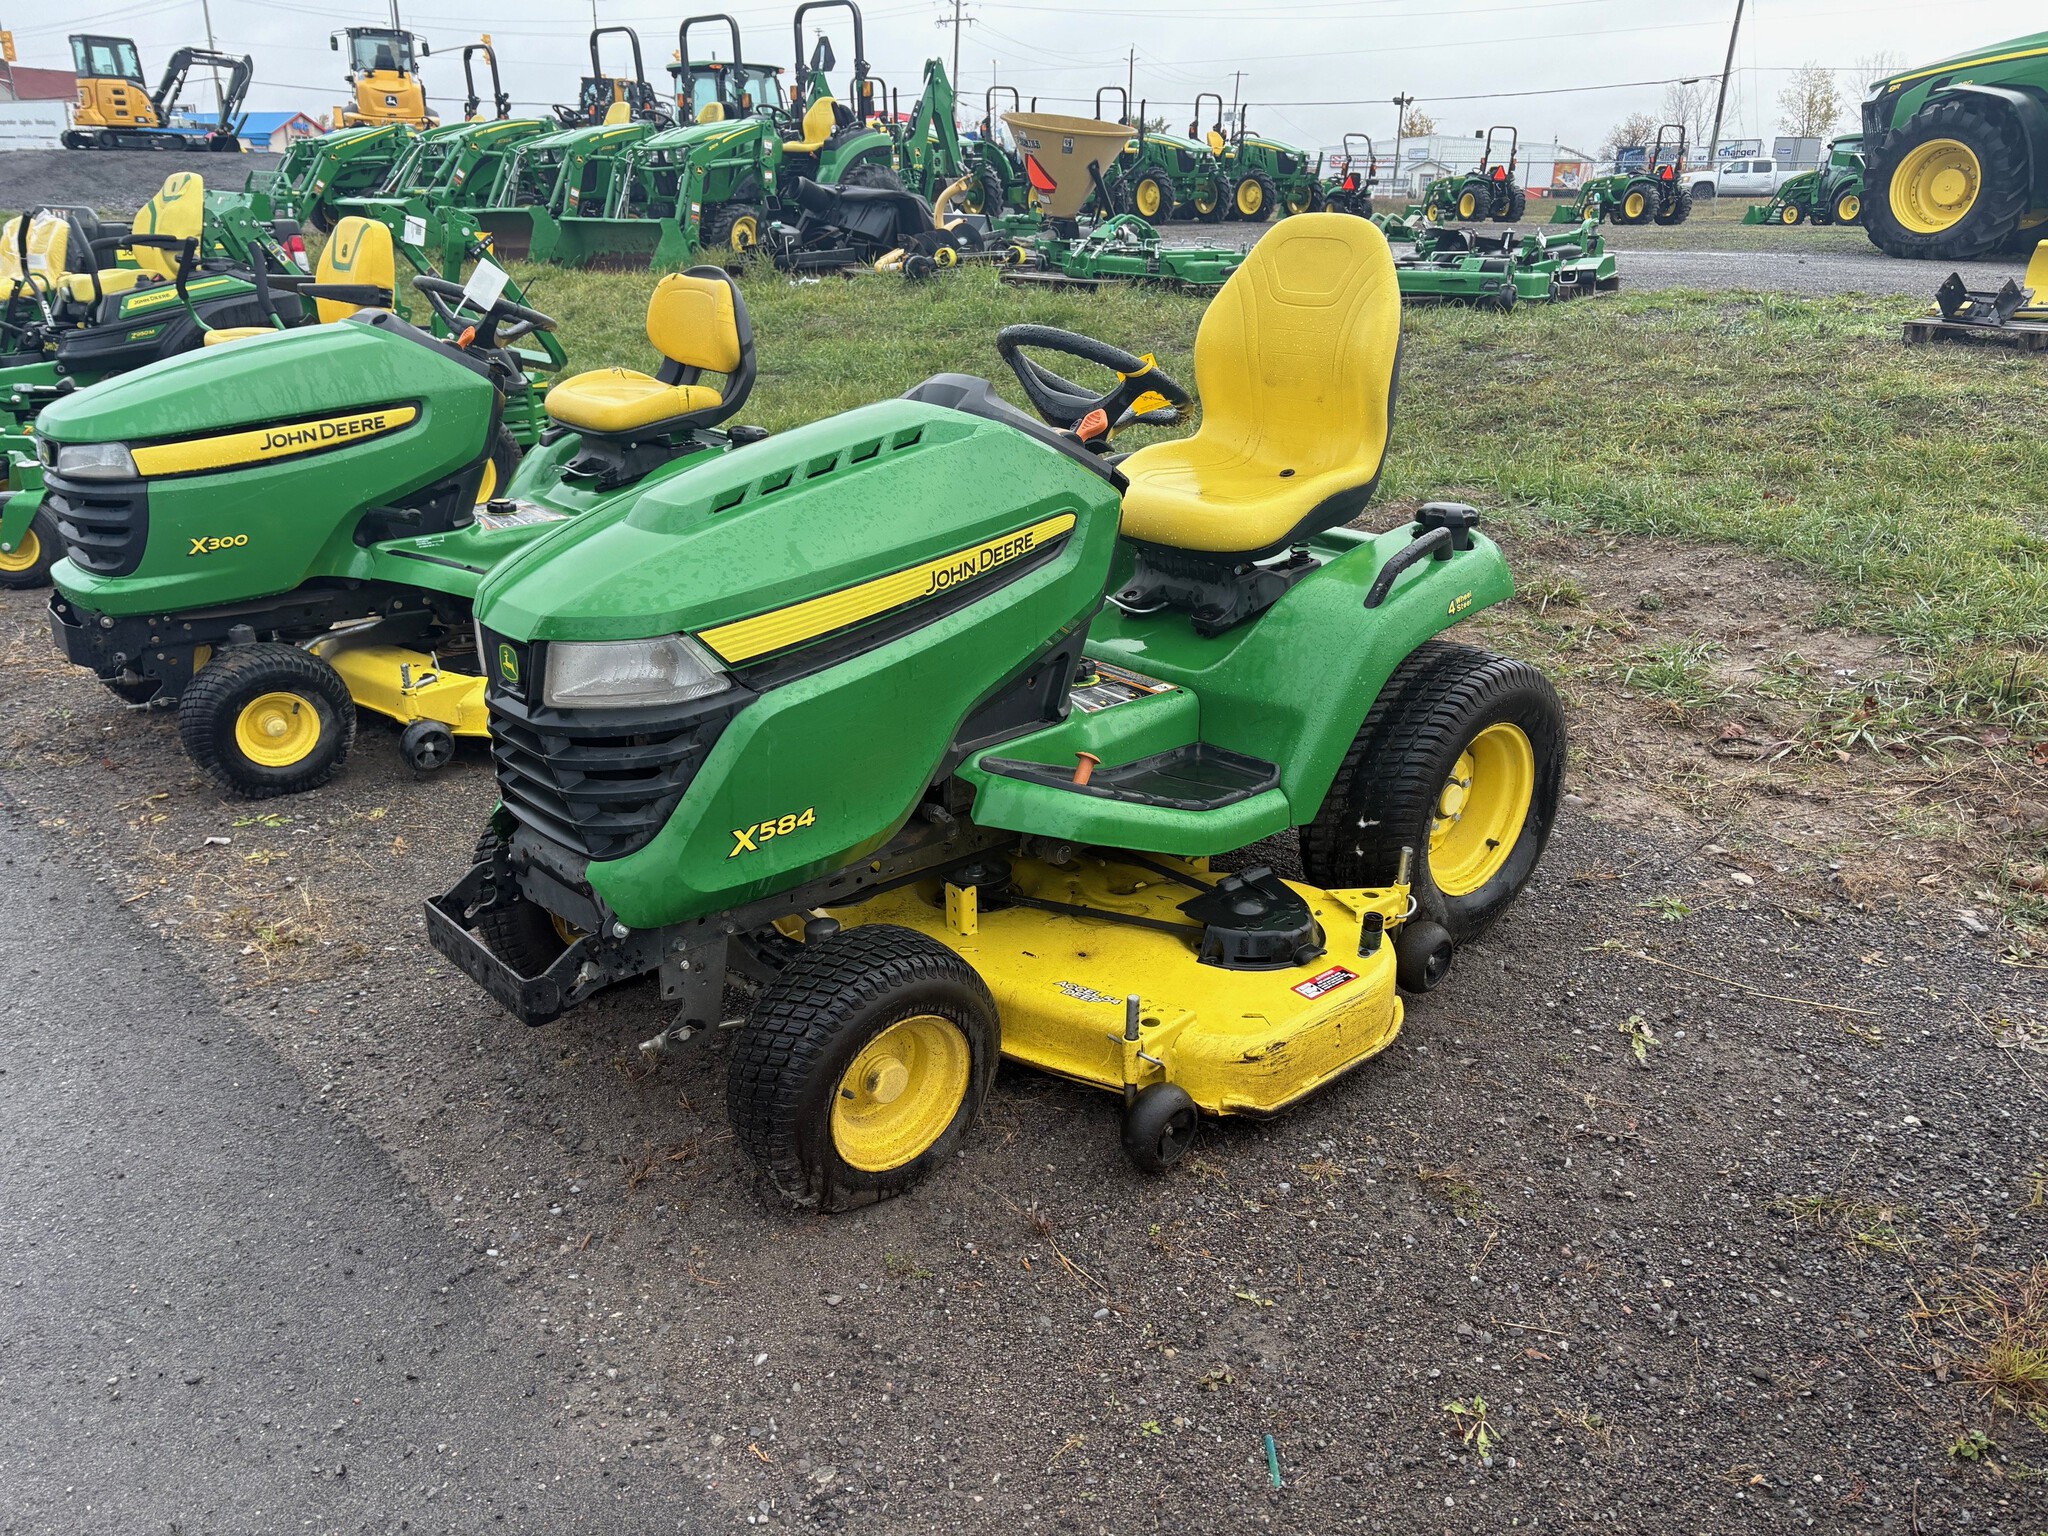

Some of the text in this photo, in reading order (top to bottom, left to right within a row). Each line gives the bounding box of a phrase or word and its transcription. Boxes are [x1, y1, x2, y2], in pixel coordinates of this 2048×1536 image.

[1718, 147, 1757, 159] Charger
[134, 293, 170, 305] JOHN DEERE
[260, 416, 386, 450] JOHN DEERE
[188, 533, 249, 555] X300
[925, 531, 1034, 594] JOHN DEERE
[1448, 590, 1472, 615] 4 Wheel
[1457, 599, 1472, 612] Steer
[726, 806, 816, 859] X584
[1053, 981, 1101, 999] ACCEL
[1060, 988, 1101, 1002] DEEP
